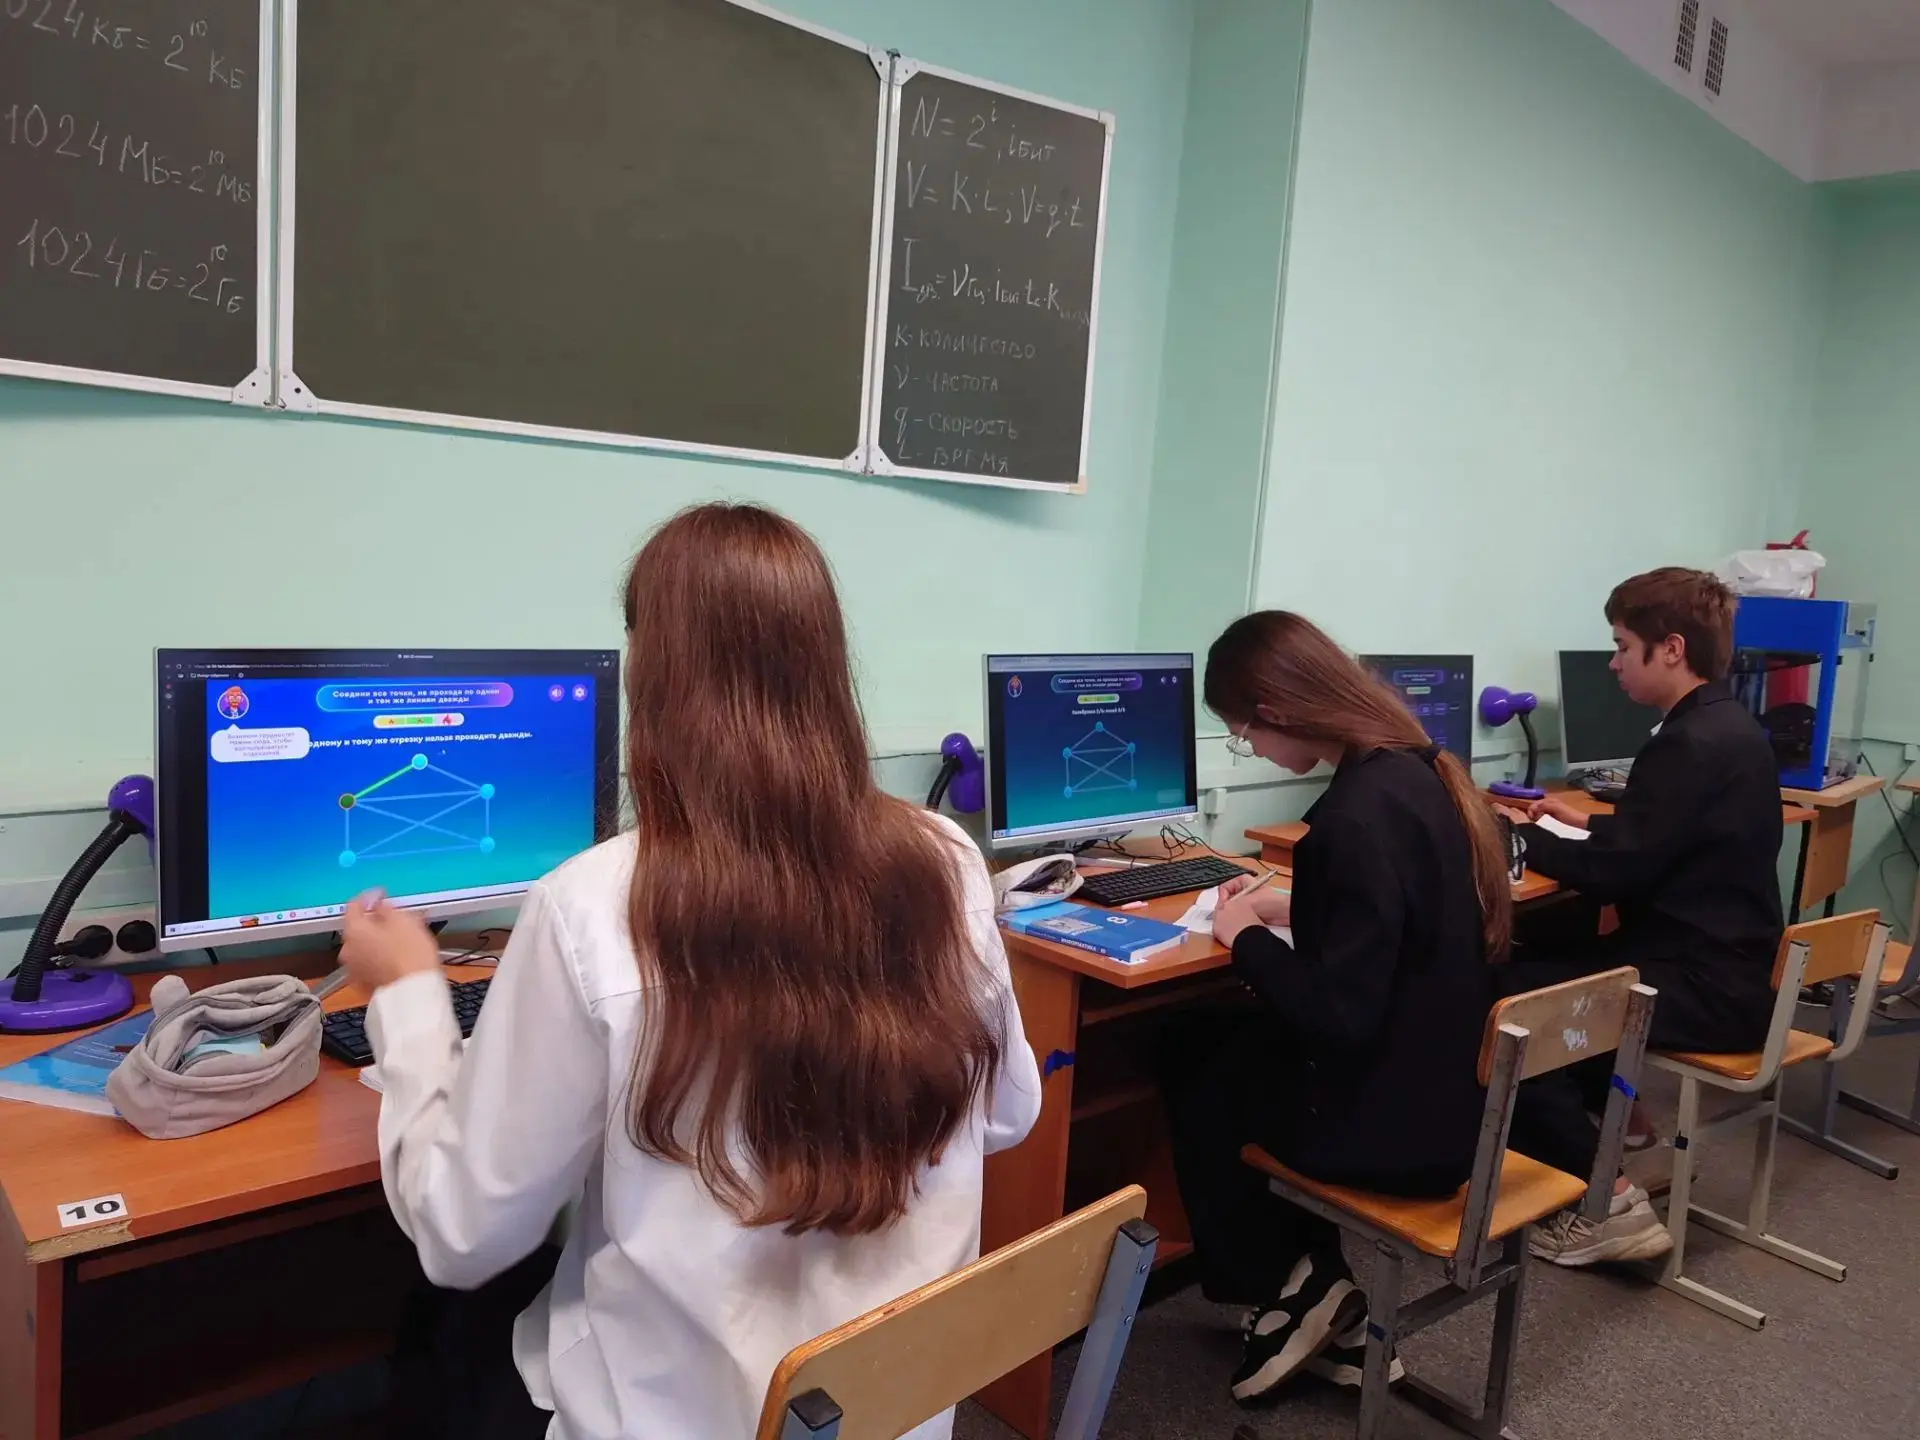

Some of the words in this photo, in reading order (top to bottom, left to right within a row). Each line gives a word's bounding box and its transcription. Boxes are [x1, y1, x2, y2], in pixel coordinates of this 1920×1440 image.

[926, 370, 999, 394] ЧАСТОТА
[929, 412, 1018, 440] СКОРОСТЬ
[332, 690, 371, 699] Соедини
[373, 690, 388, 698] все
[351, 738, 373, 748] тому
[375, 737, 388, 745] же
[389, 736, 424, 745] отрезку
[425, 735, 454, 743] нельзя
[455, 732, 497, 742] проходить
[498, 731, 533, 740] дважды.
[66, 1200, 121, 1220] 10
